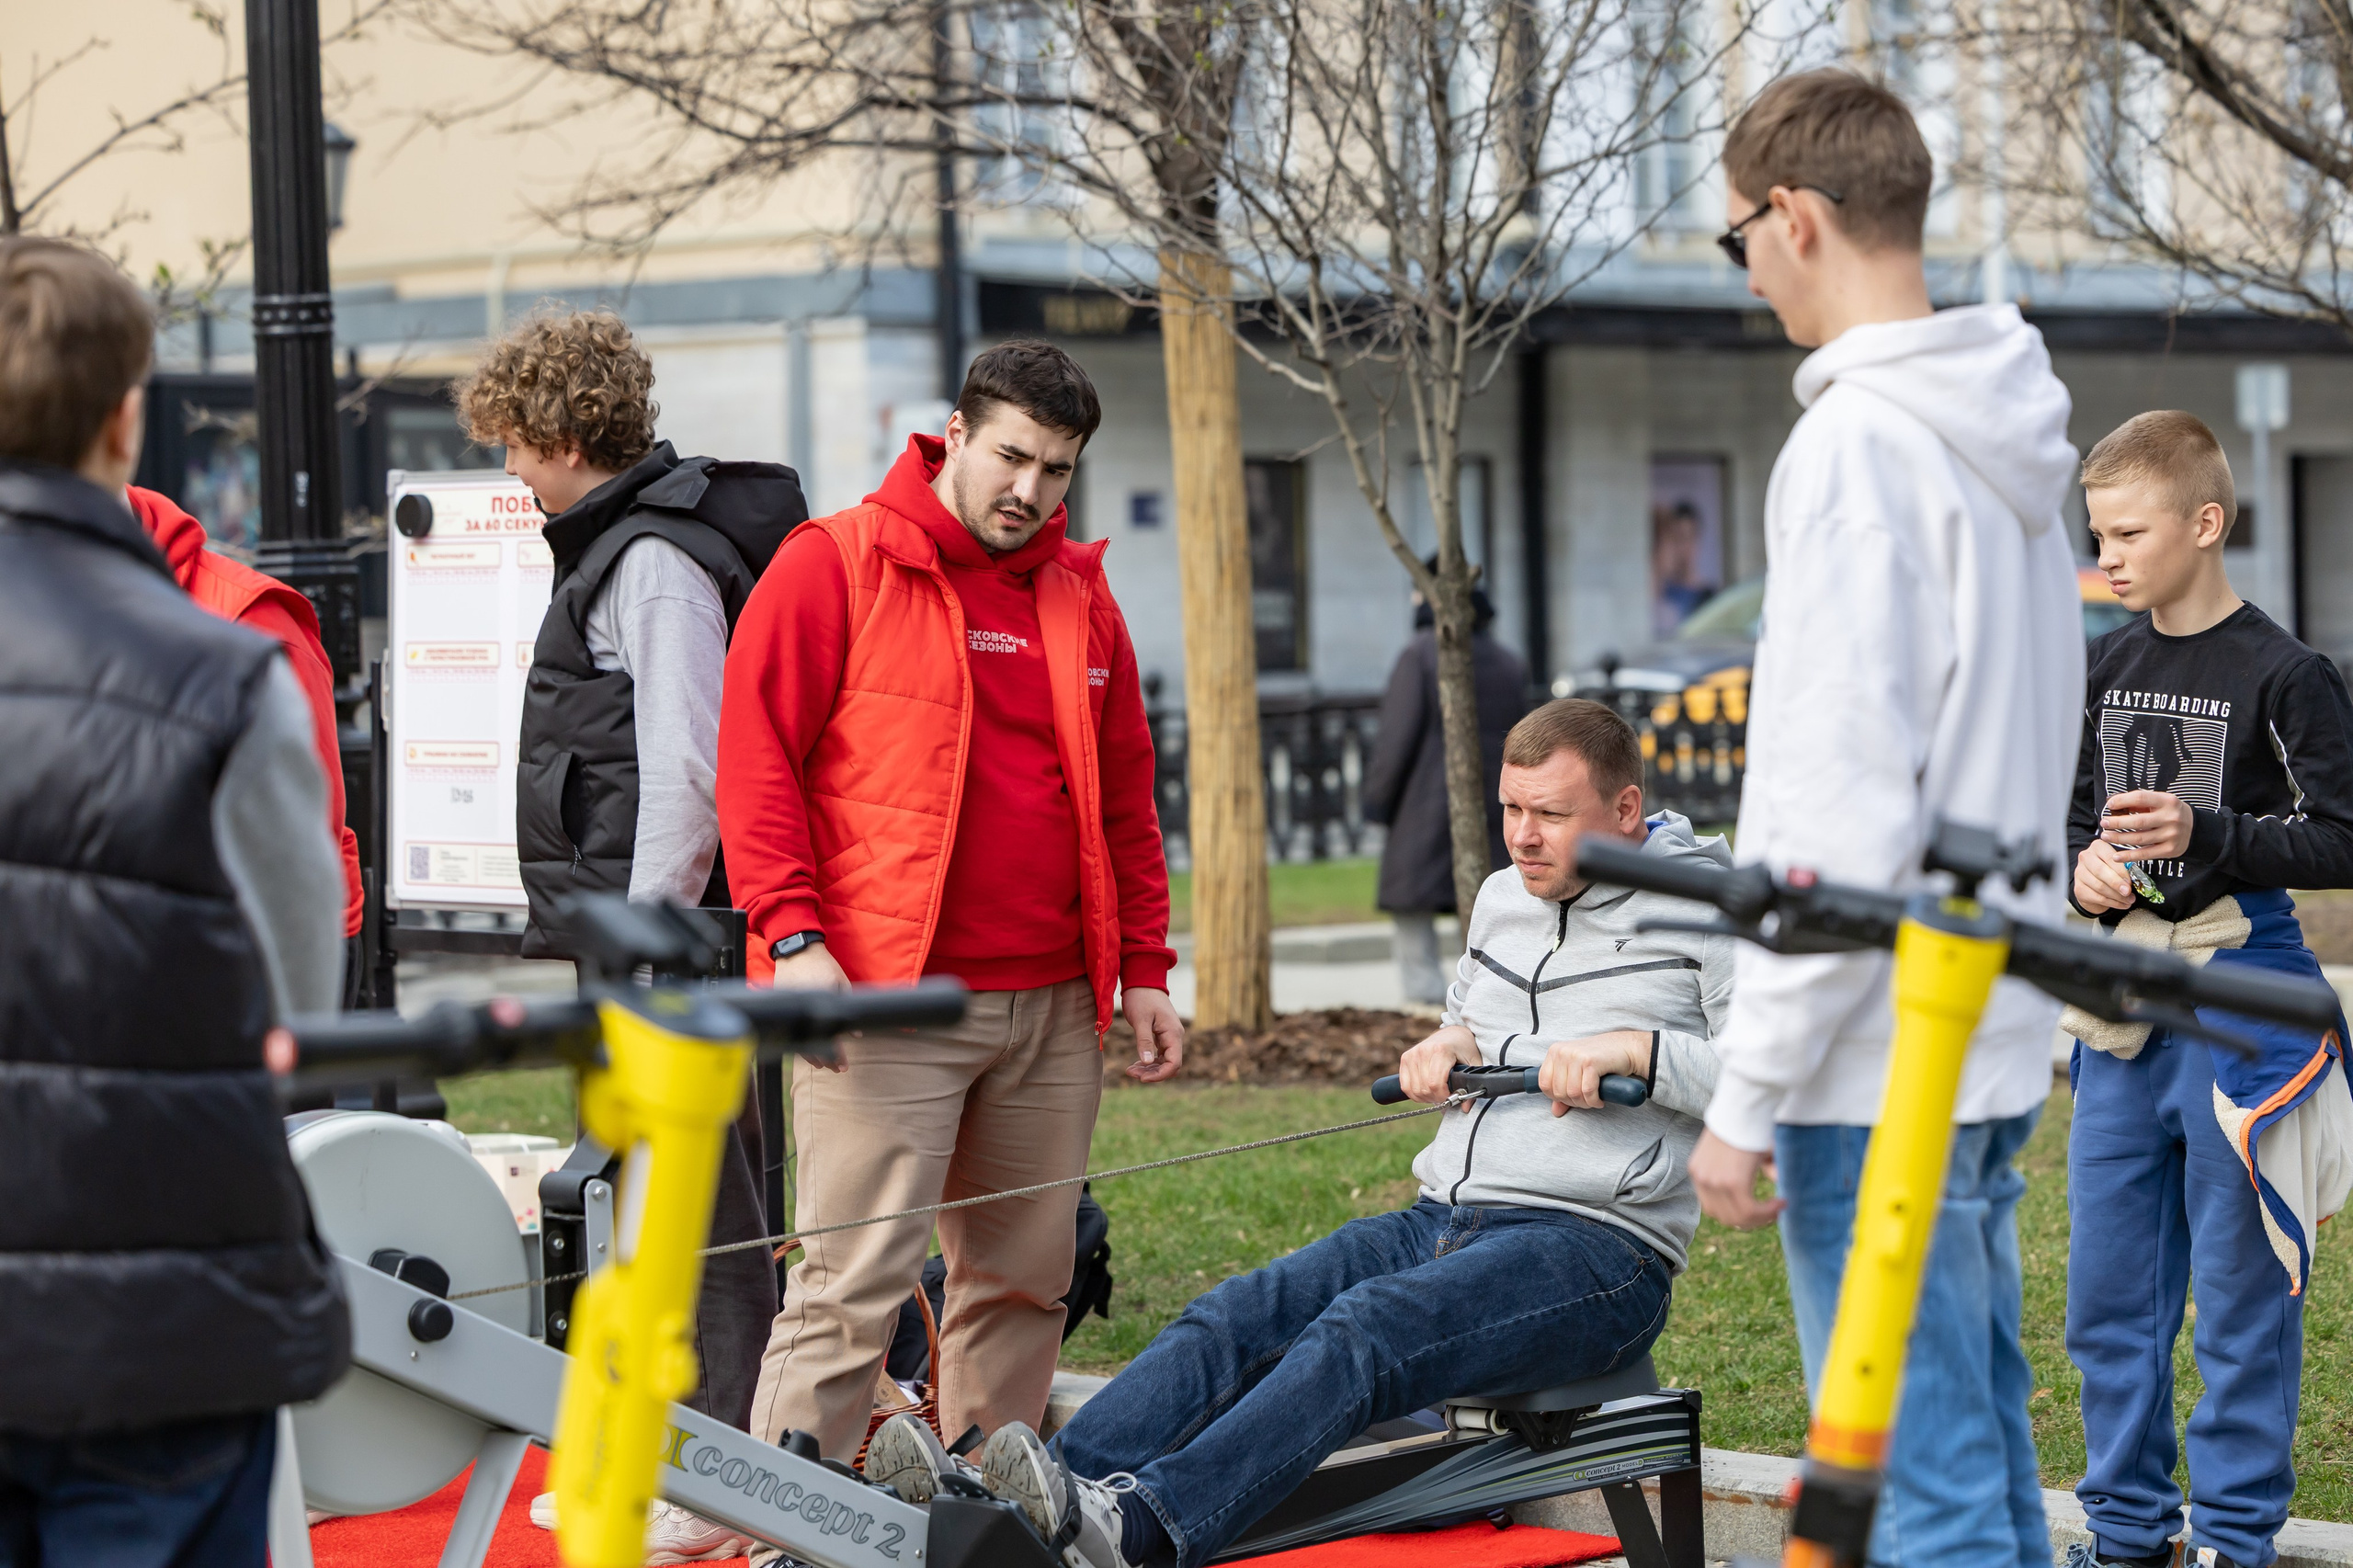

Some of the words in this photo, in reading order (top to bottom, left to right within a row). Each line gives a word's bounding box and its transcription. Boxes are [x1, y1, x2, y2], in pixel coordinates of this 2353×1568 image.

[492, 496, 540, 514] ПОБ
[465, 519, 481, 531] ЗА
[485, 518, 500, 531] 60
[2103, 689, 2231, 718] SKATEBOARDING
[1586, 1464, 1616, 1477] concept
[693, 1445, 875, 1545] concept
[874, 1522, 906, 1559] 2
